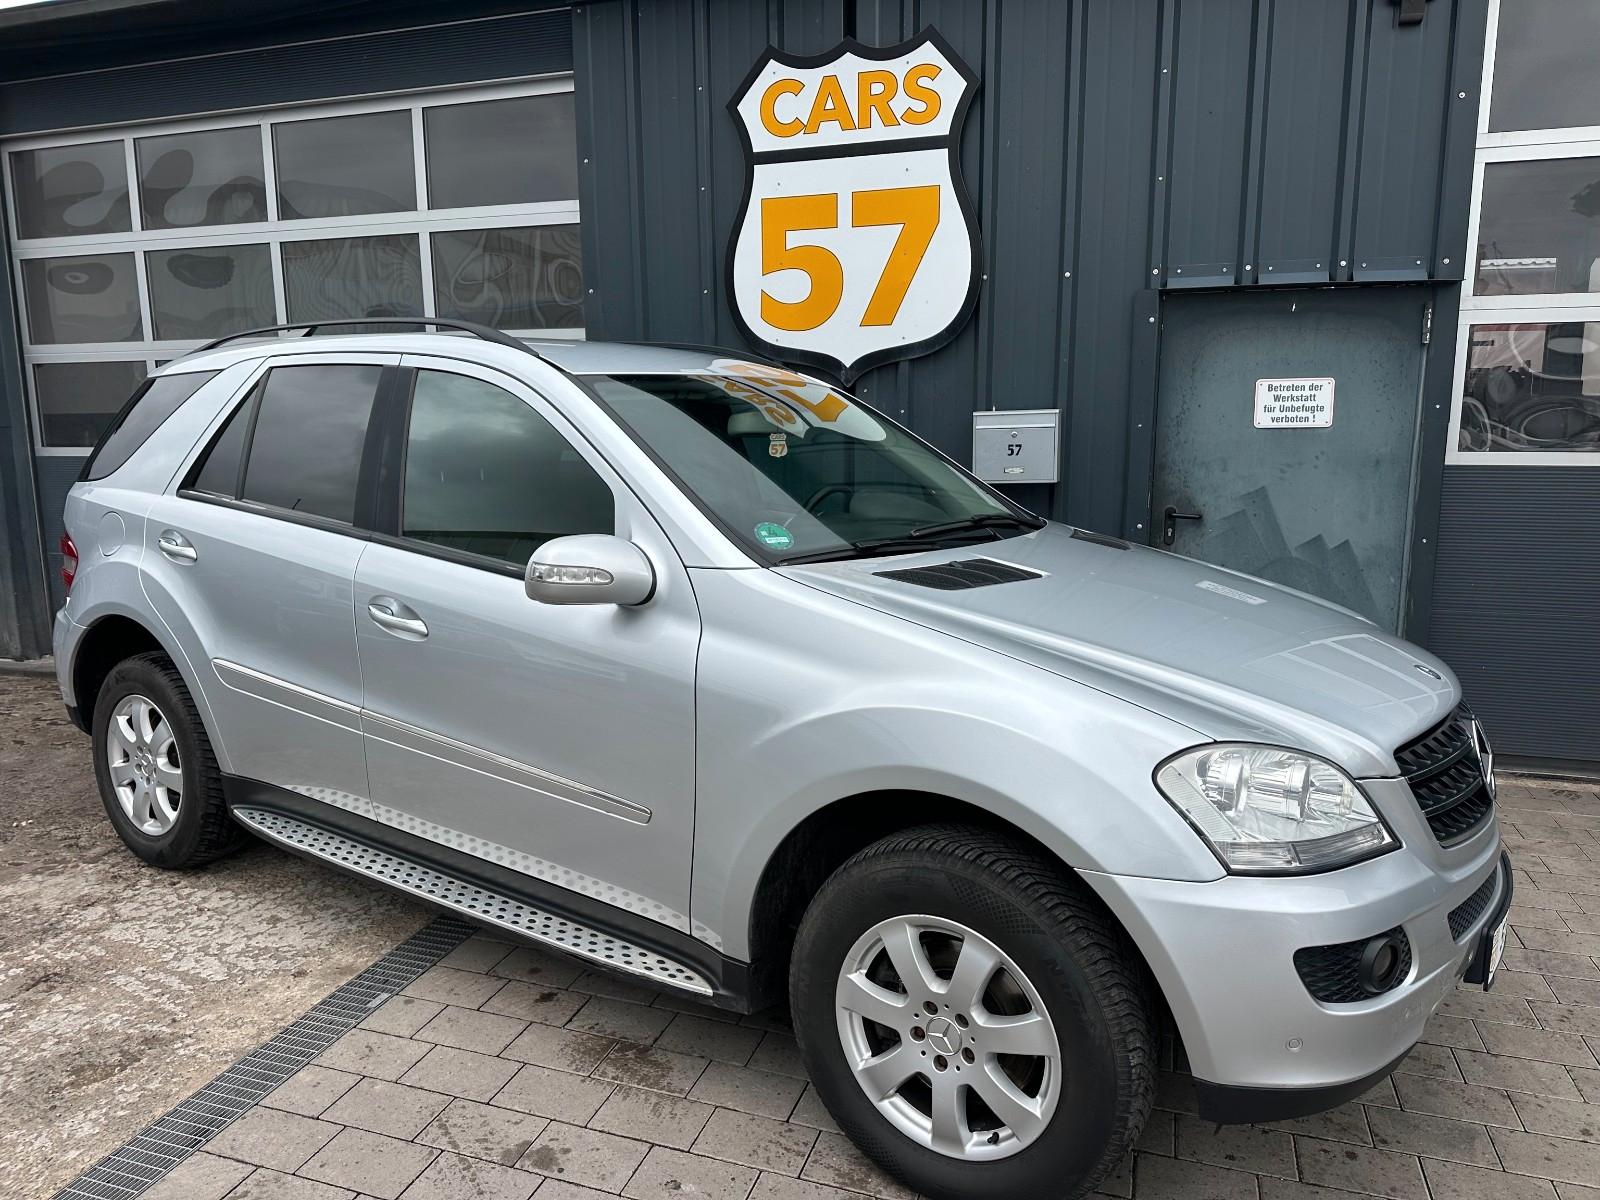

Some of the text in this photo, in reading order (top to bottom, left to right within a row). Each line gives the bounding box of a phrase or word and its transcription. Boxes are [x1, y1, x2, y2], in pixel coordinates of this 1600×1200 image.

[760, 63, 942, 138] CARS
[760, 185, 940, 331] 57
[1267, 383, 1323, 392] Betreten der
[1273, 394, 1316, 402] Werkstatt
[1263, 404, 1325, 413] für Unbefugte
[1271, 415, 1309, 423] verboten
[771, 444, 785, 455] 57
[1007, 444, 1022, 456] 57
